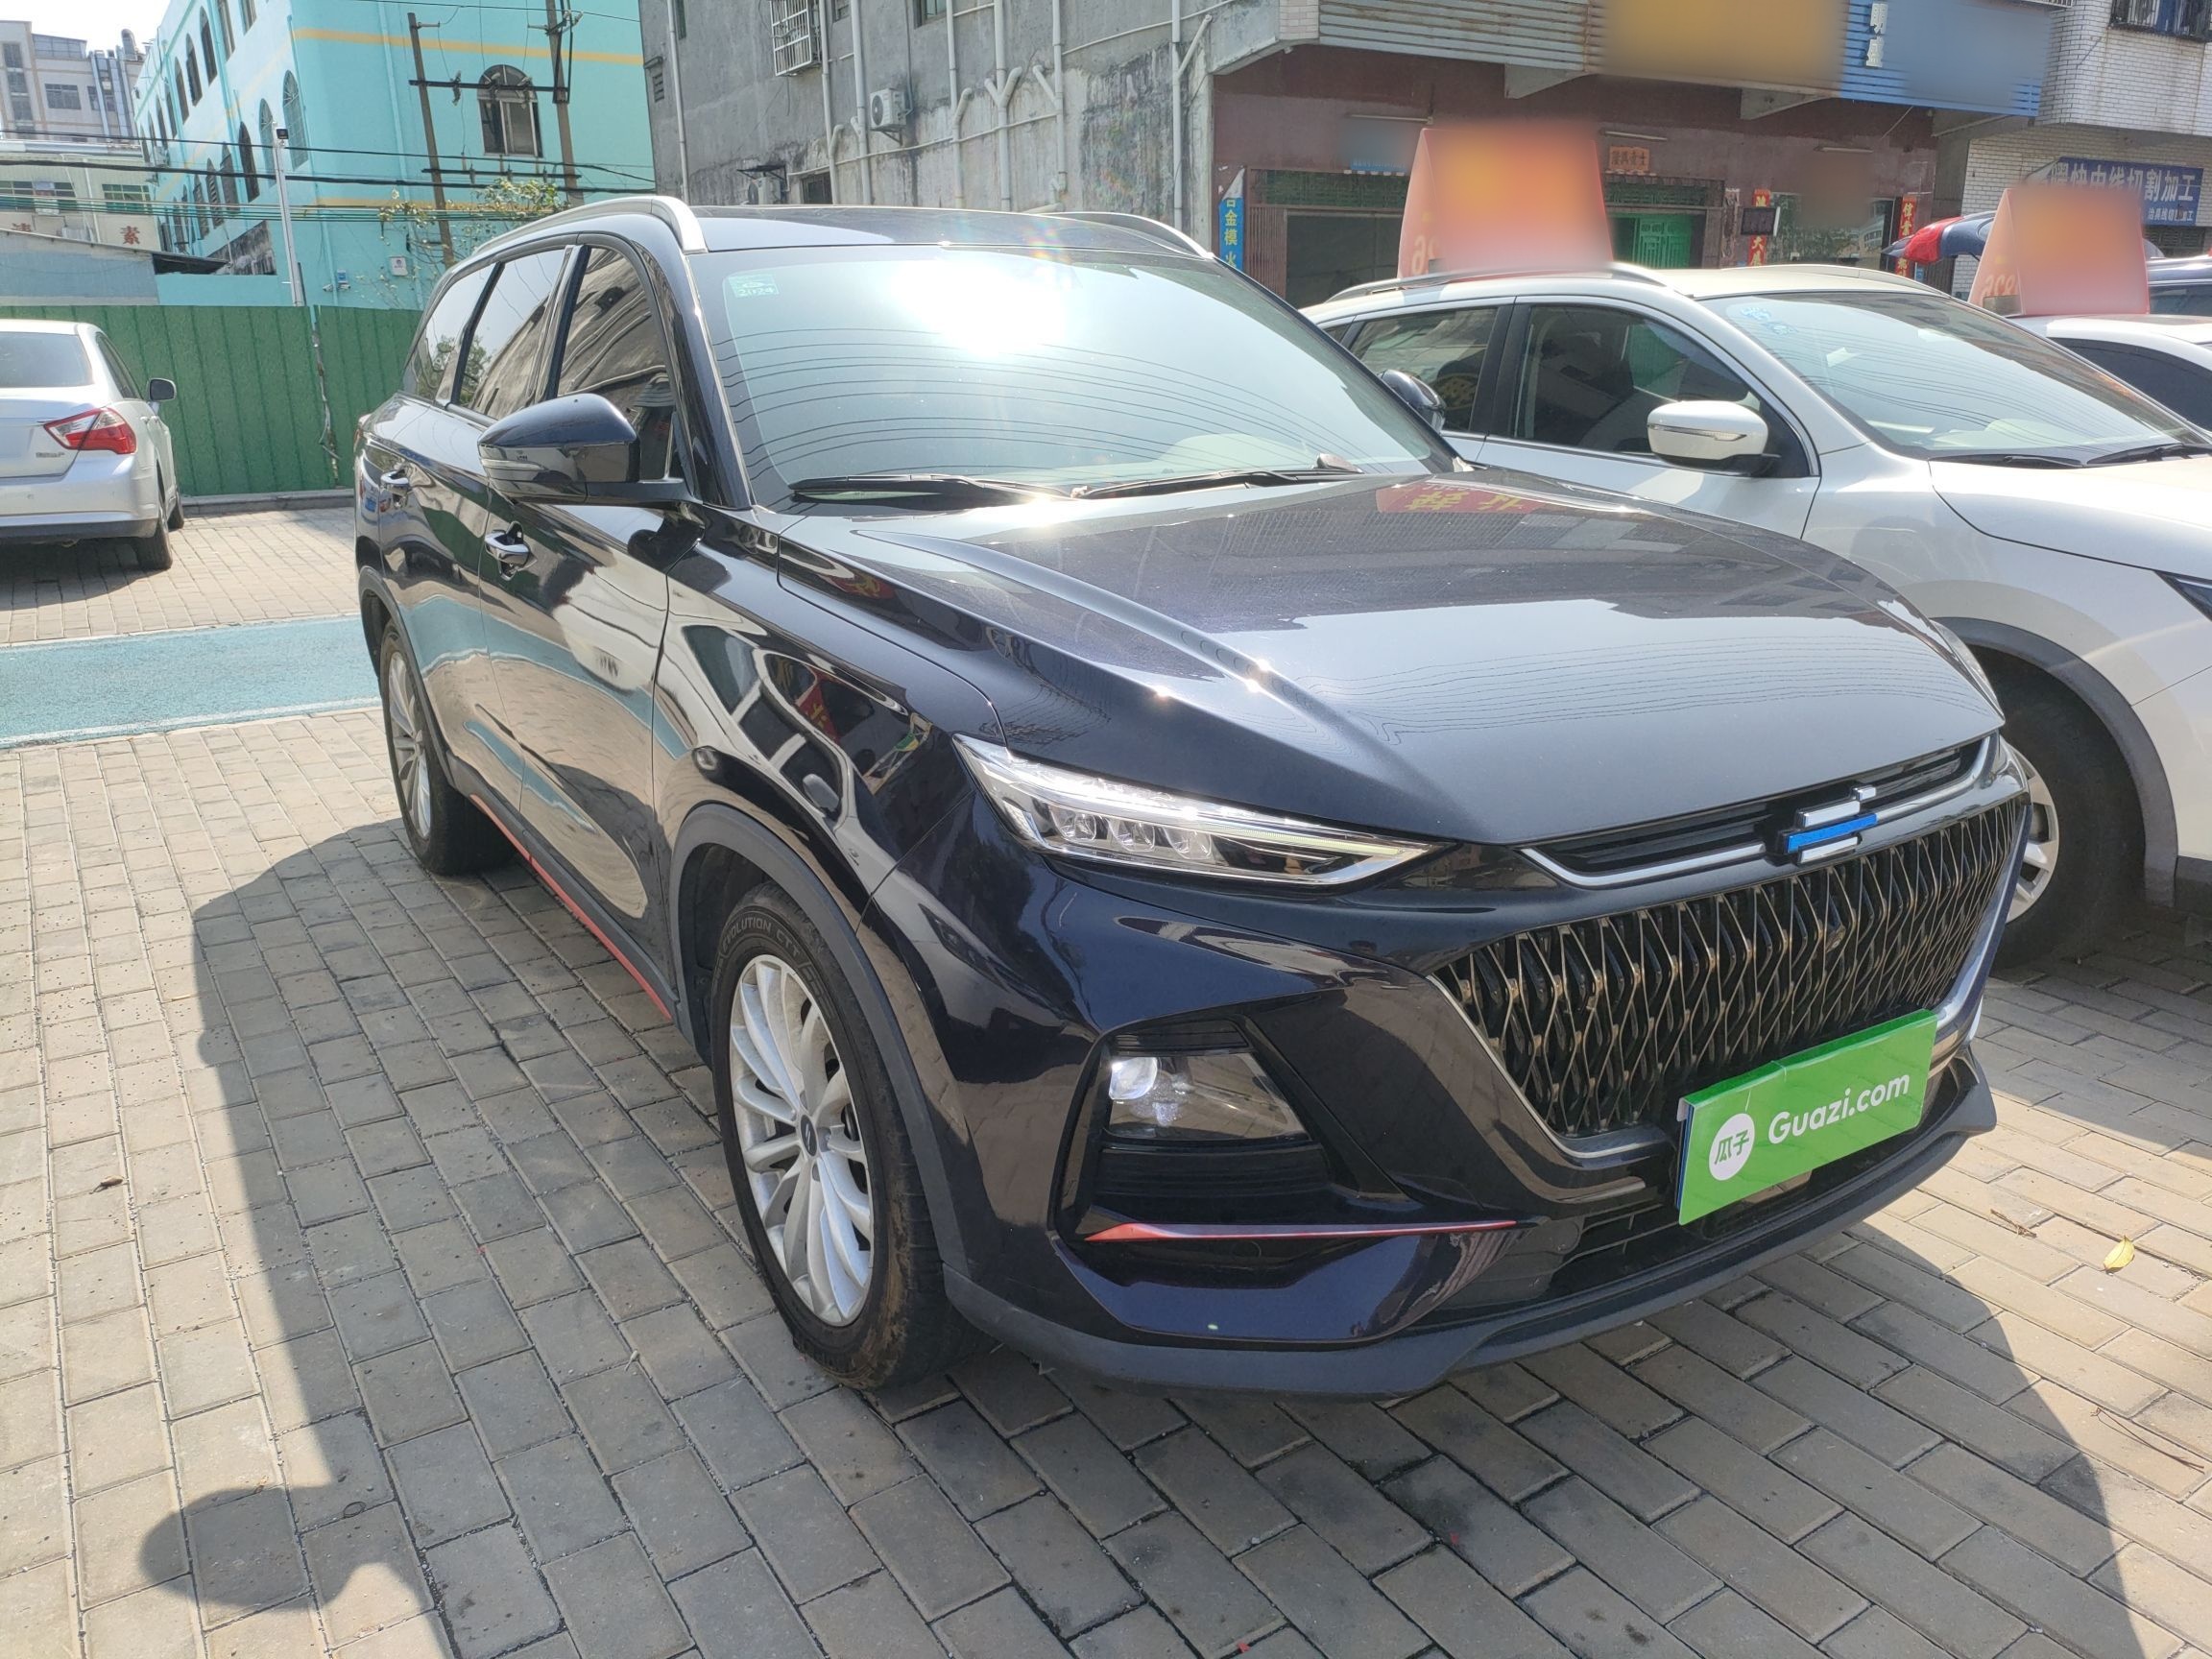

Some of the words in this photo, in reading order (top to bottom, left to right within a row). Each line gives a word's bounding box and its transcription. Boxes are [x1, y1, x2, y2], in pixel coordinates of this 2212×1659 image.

[722, 916, 772, 954] EVOLUTION
[776, 928, 802, 957] CTT
[1767, 1074, 1911, 1145] Guazi.com
[1713, 1128, 1750, 1166] 瓜子
